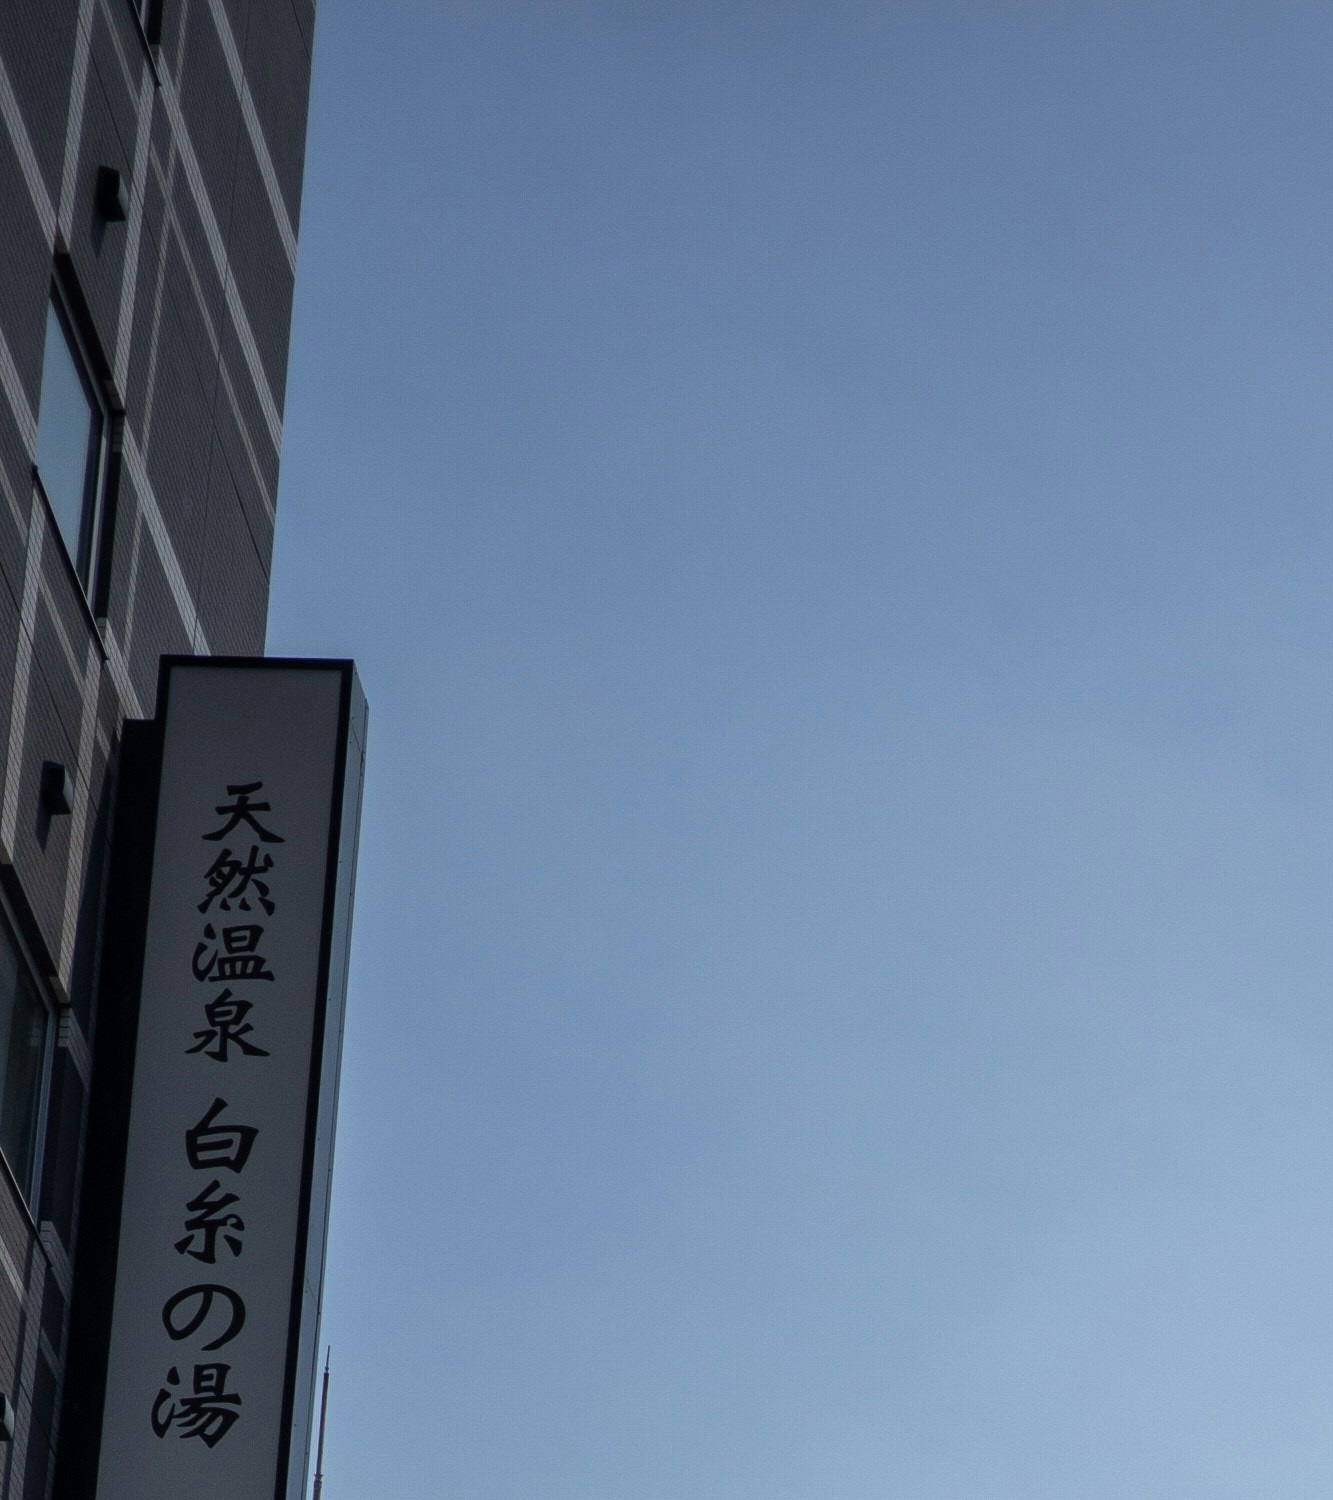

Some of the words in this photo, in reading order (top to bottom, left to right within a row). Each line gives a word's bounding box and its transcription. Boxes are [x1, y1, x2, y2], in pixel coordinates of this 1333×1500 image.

[185, 780, 287, 1061] 天然温泉
[150, 1097, 260, 1451] 白糸の湯
